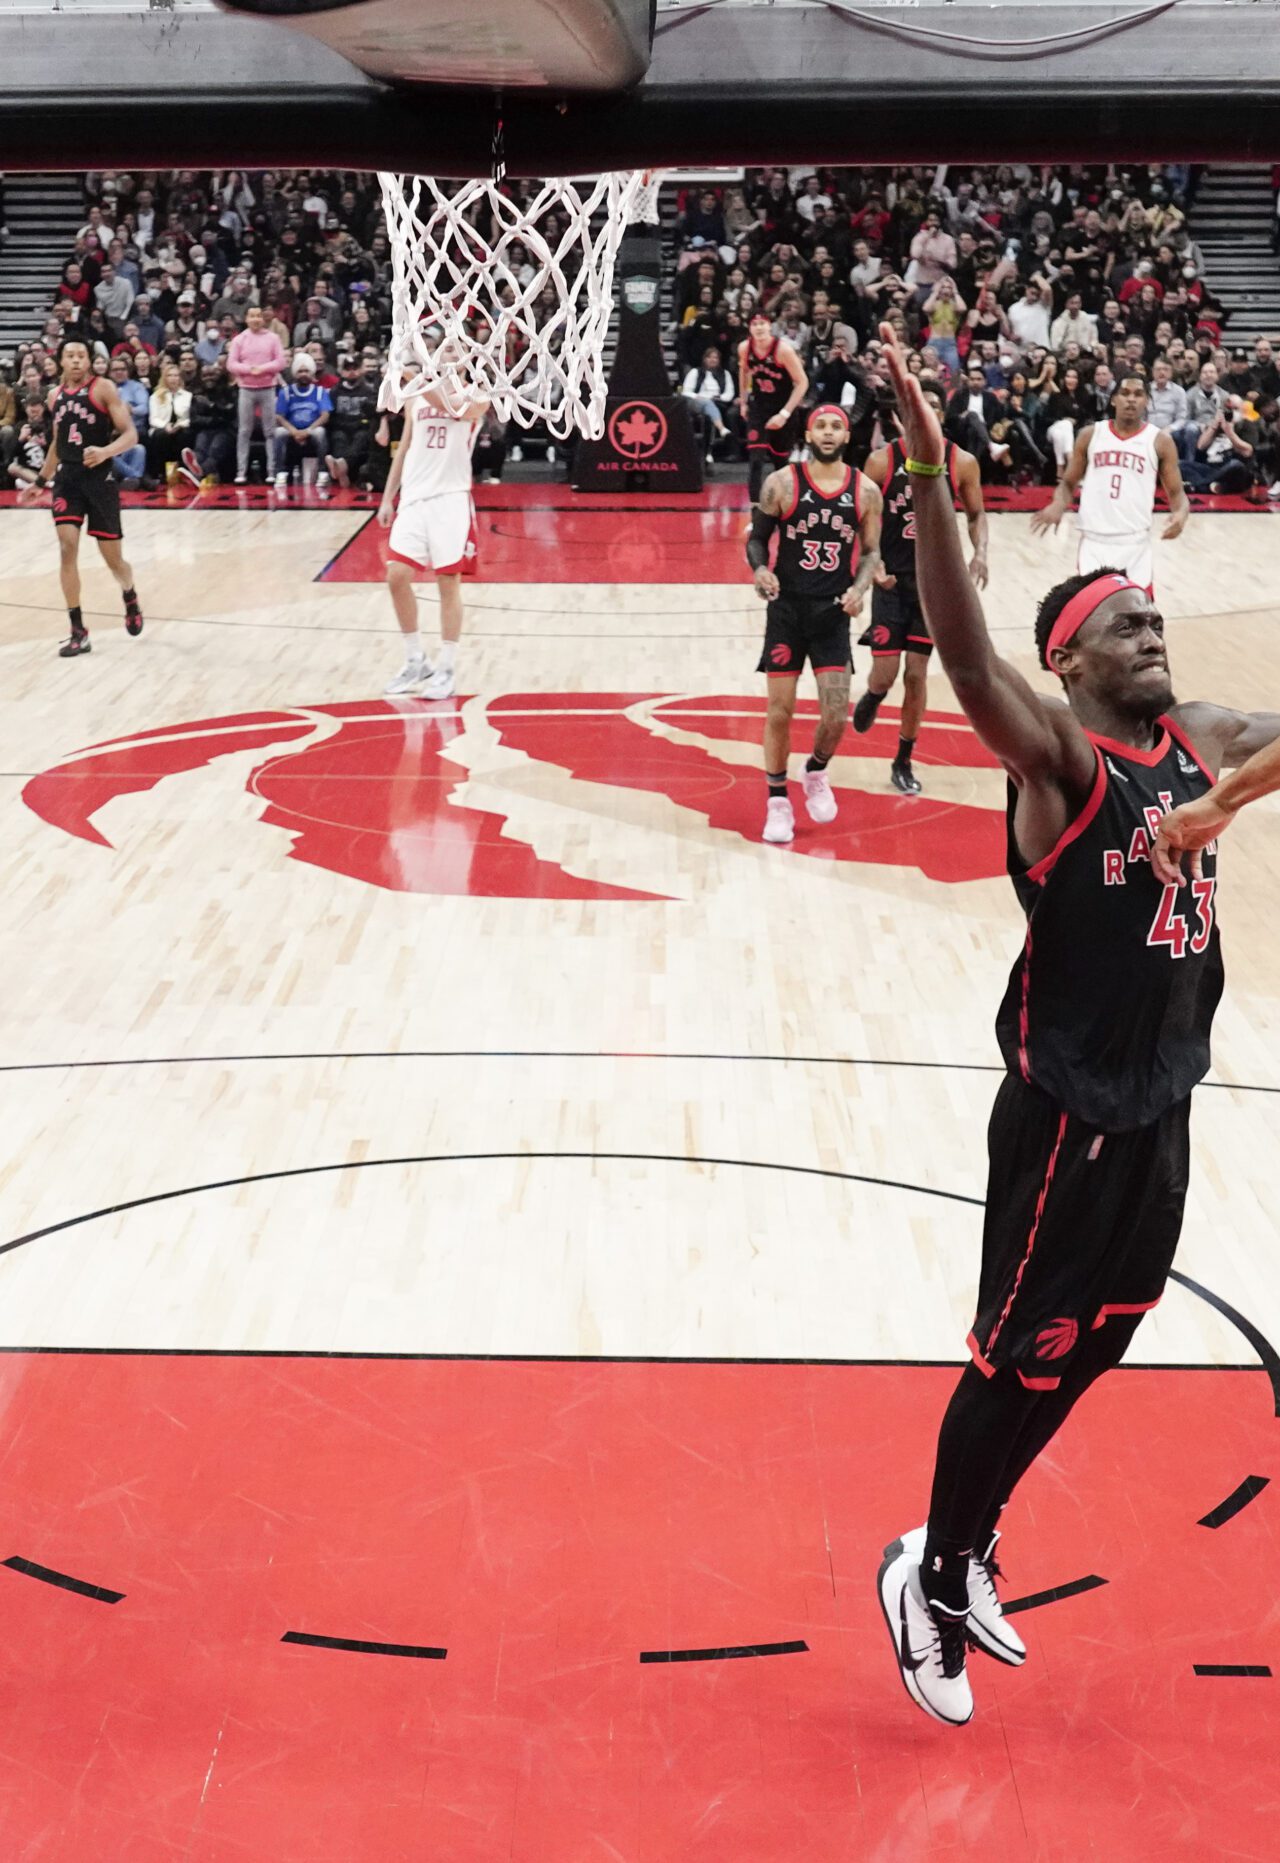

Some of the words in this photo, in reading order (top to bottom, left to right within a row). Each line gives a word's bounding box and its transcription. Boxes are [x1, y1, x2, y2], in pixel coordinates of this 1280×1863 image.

[67, 423, 83, 446] 4
[427, 425, 447, 449] 28
[597, 462, 619, 472] AIR
[622, 462, 679, 472] CANADA
[1094, 450, 1146, 475] ROCKETS
[1110, 474, 1122, 500] 9
[799, 540, 841, 572] 33
[1103, 790, 1217, 886] RAPT
[1146, 876, 1216, 960] 43
